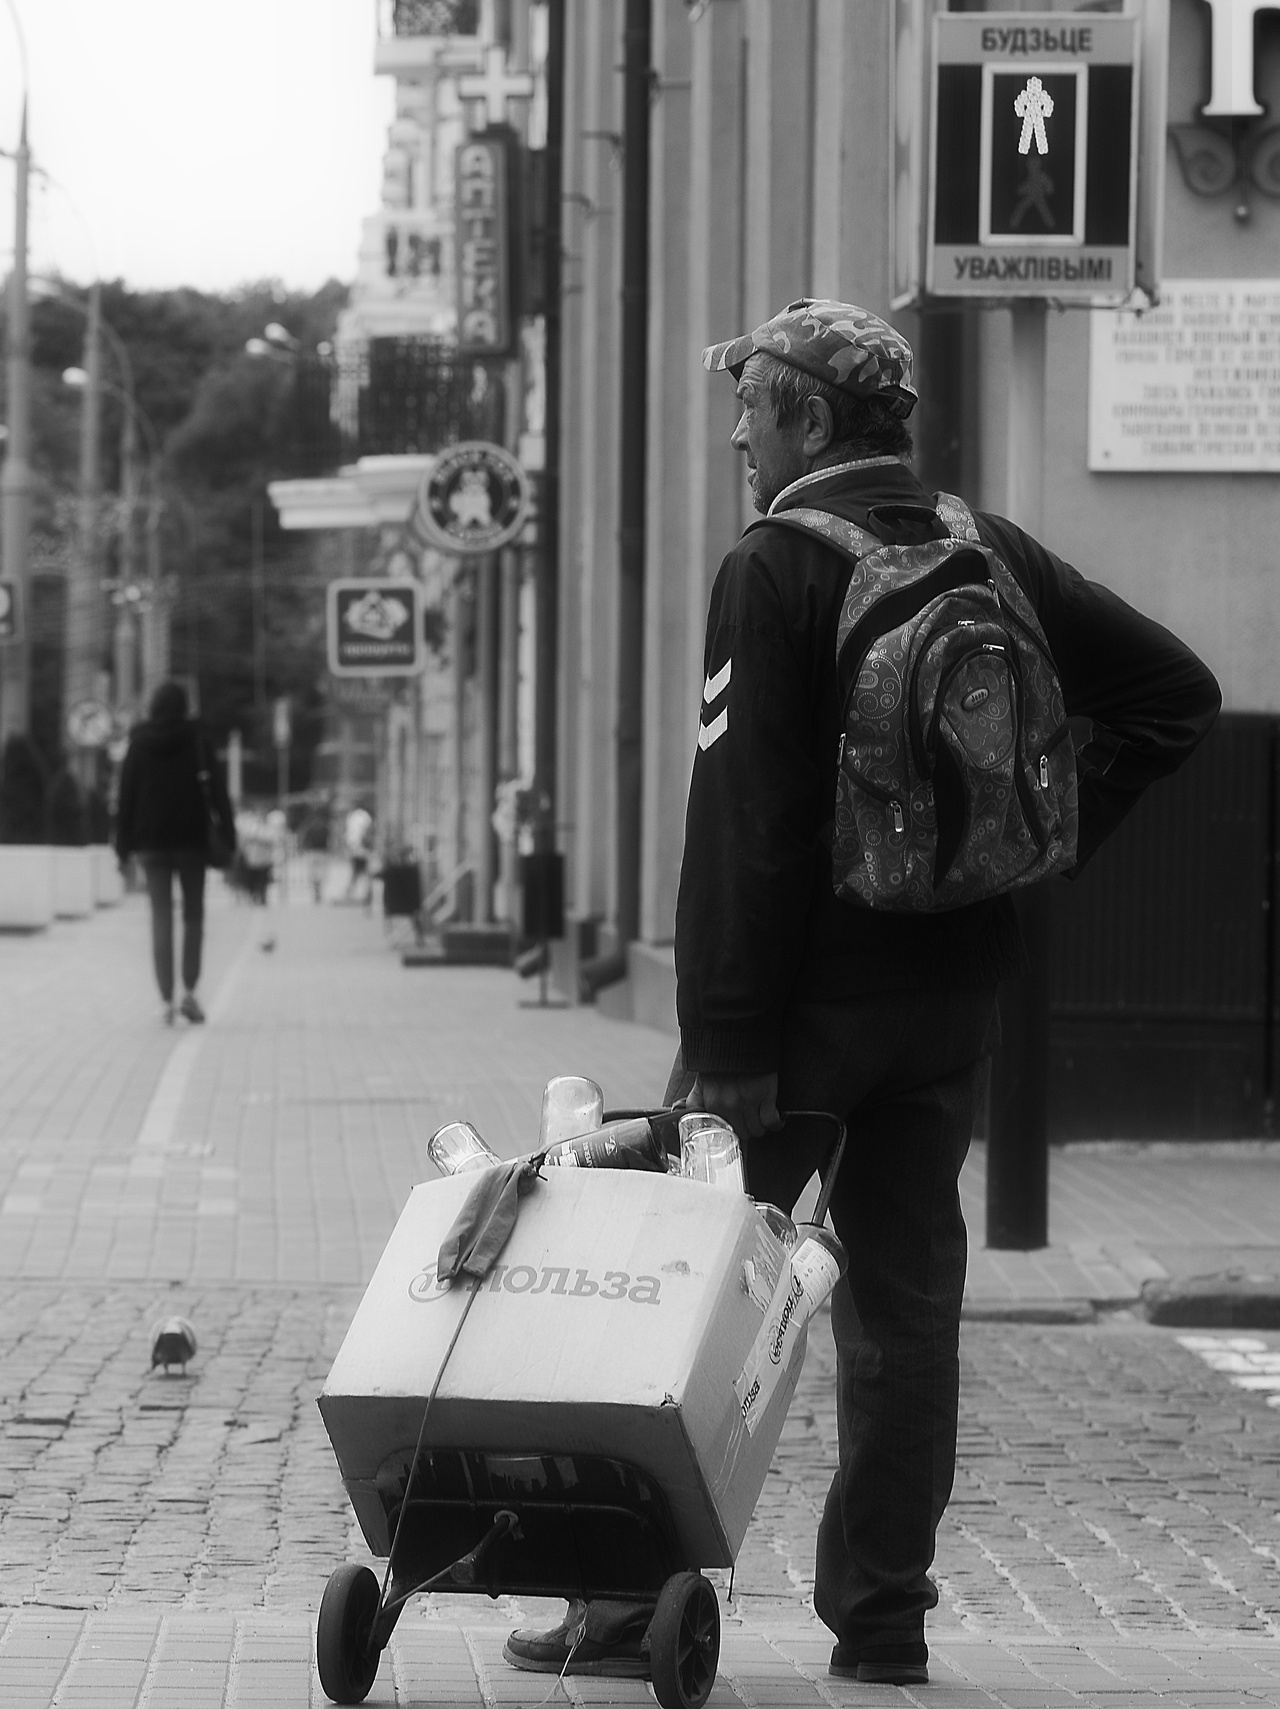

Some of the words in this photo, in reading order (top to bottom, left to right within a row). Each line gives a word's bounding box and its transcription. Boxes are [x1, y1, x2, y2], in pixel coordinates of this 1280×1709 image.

[980, 27, 1093, 55] БУДЗЬЦЕ
[460, 145, 495, 345] АПТЕКА
[953, 256, 1113, 282] УВАЖЛІВЫМІ
